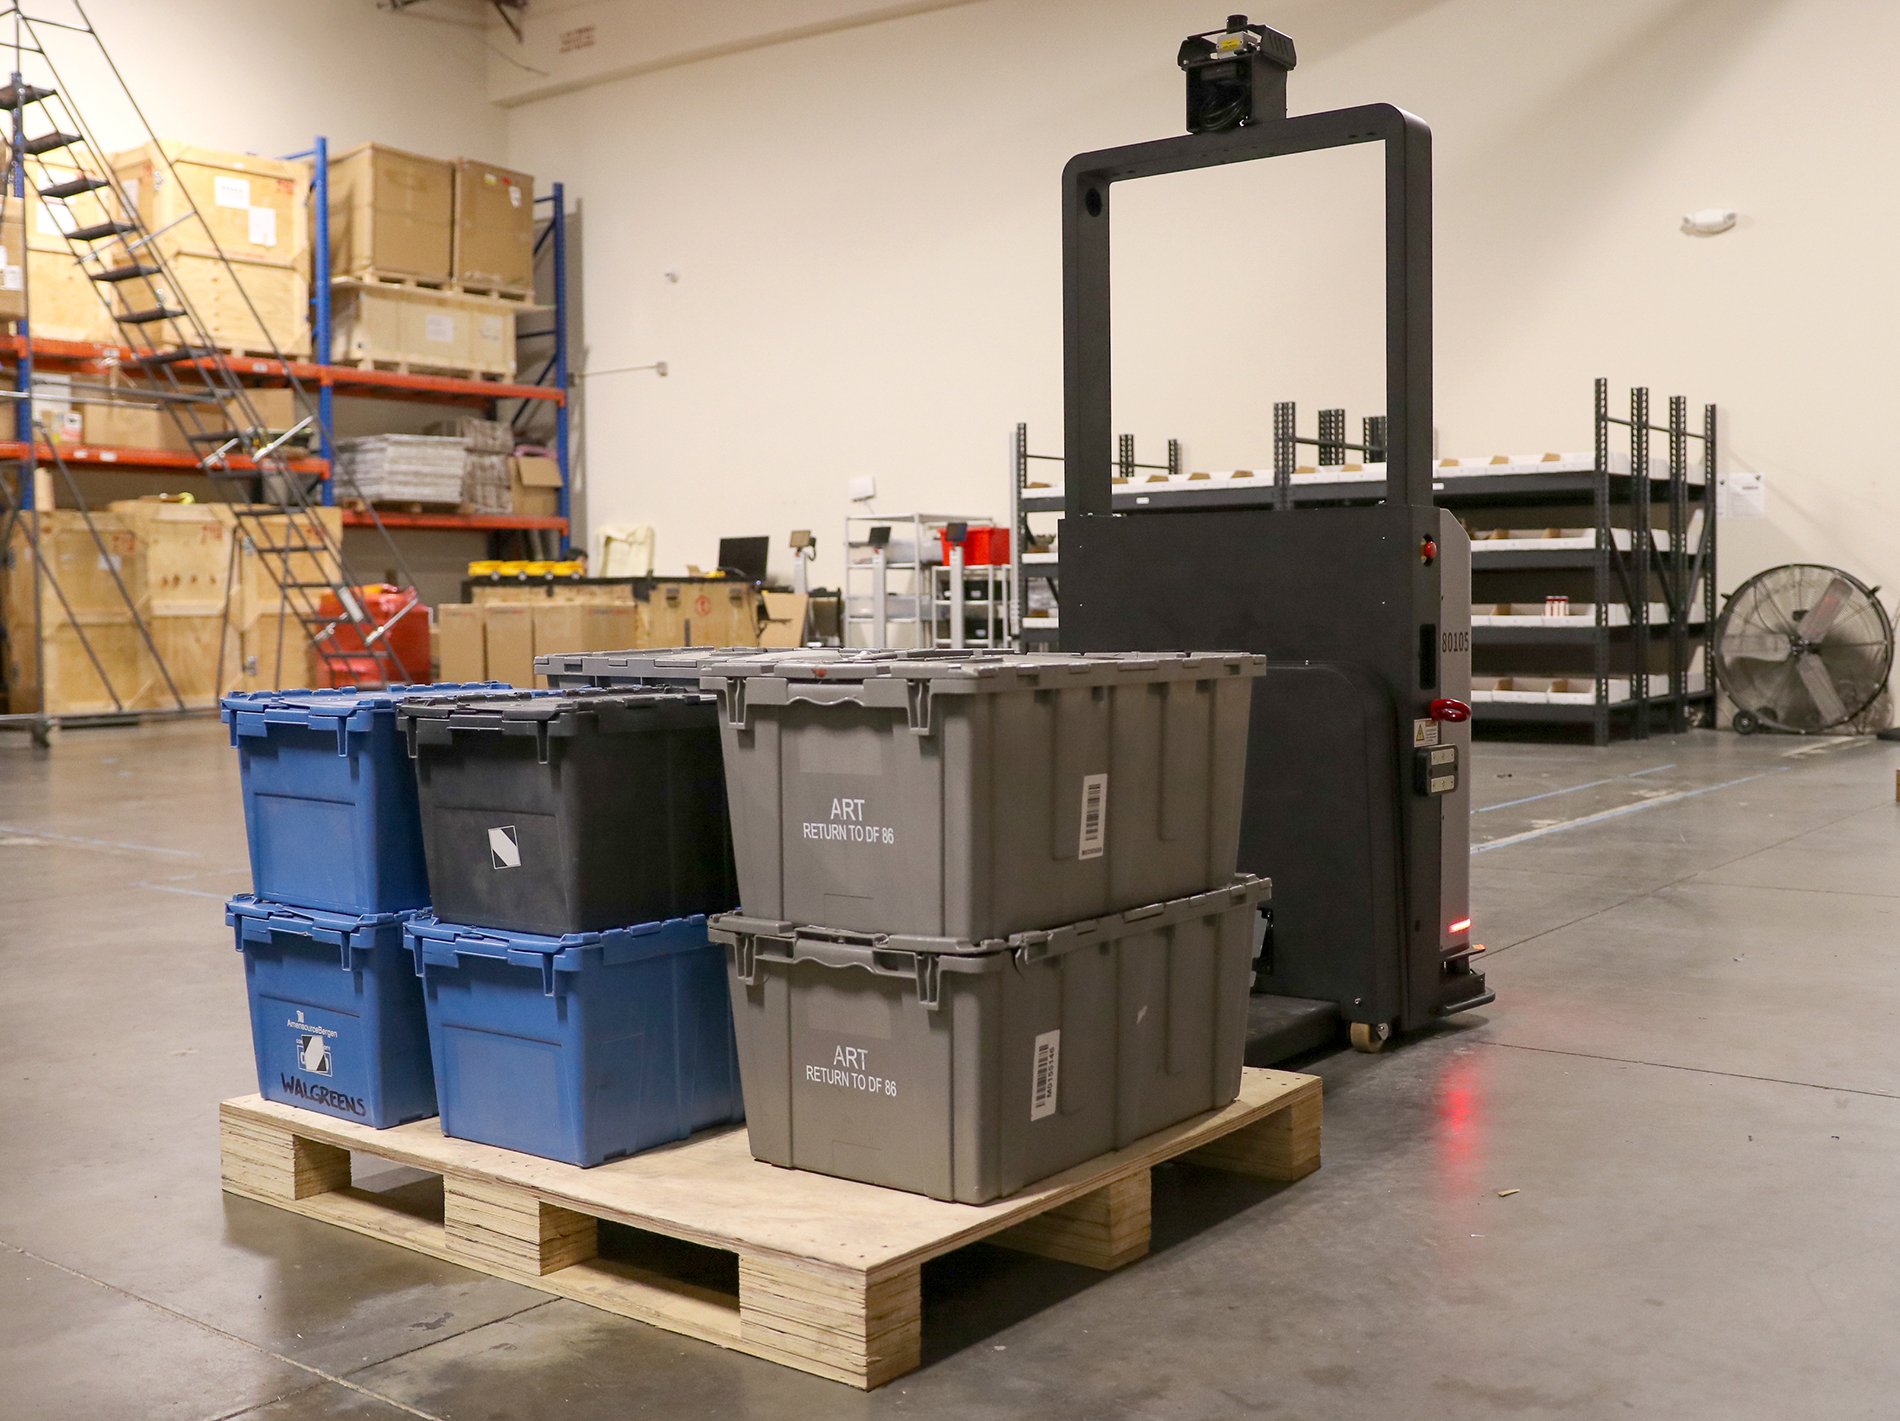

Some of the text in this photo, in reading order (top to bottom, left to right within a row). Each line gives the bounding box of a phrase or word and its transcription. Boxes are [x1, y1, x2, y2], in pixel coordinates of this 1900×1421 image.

[1442, 632, 1469, 653] 80105
[830, 798, 865, 821] ART
[803, 823, 894, 844] RETURN TO DF 86
[833, 1045, 868, 1070] ART
[806, 1065, 897, 1097] RETURN TO DF 86
[281, 1072, 367, 1116] WALGREENS
